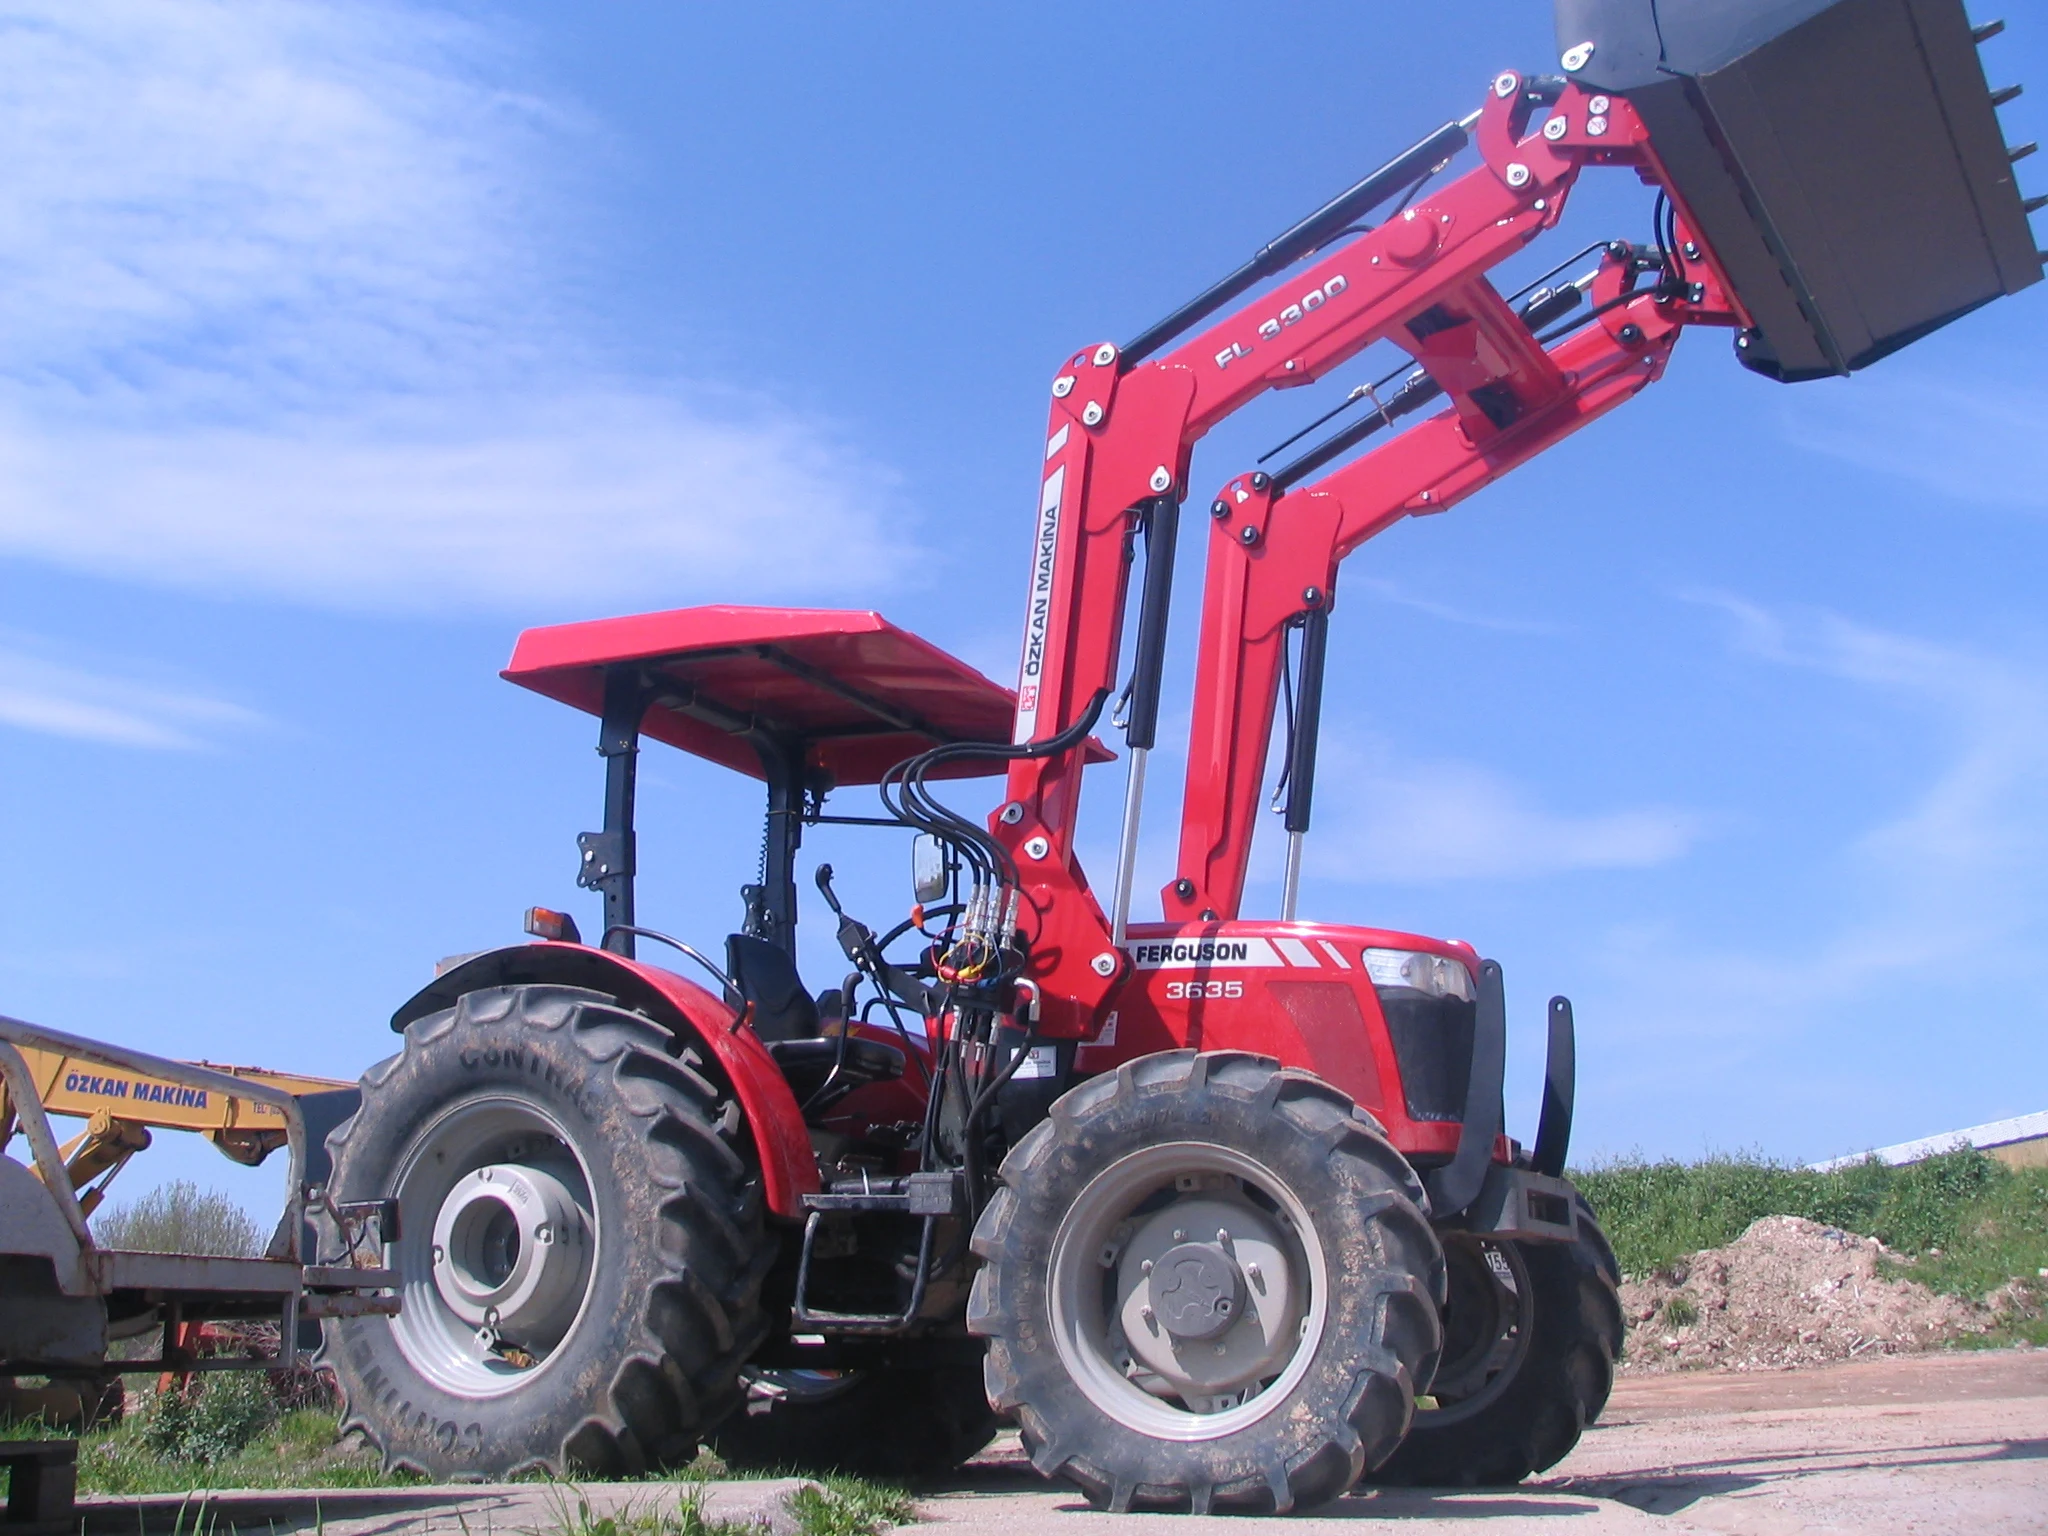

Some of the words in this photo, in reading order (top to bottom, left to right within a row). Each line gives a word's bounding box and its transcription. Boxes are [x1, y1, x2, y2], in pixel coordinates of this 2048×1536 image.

[1214, 342, 1253, 369] FL
[1257, 274, 1348, 341] 3300
[1024, 597, 1047, 676] ÖZKAN
[1037, 504, 1058, 592] MAKİNA
[1136, 943, 1248, 963] FERGUSON
[1166, 981, 1243, 999] 3635
[65, 1069, 129, 1098] ÖZKAN
[133, 1082, 208, 1109] MAKİNA
